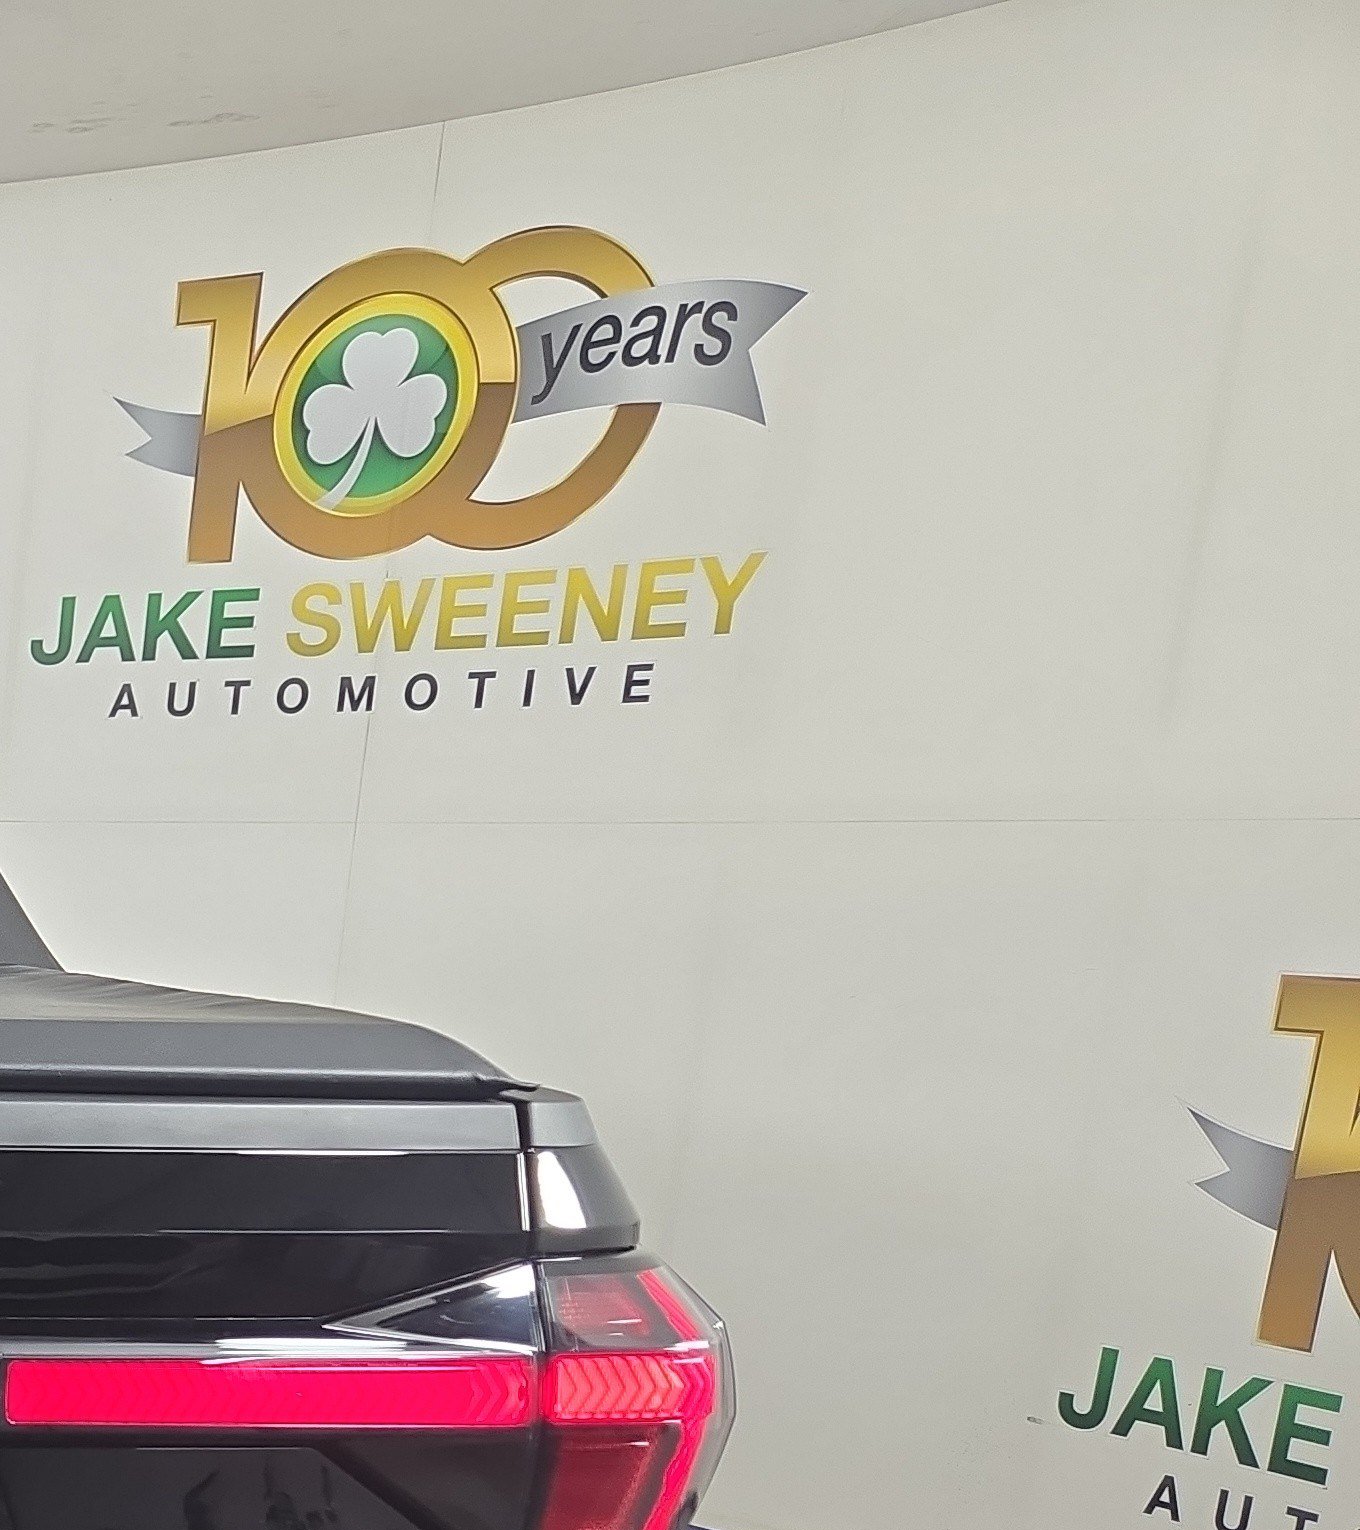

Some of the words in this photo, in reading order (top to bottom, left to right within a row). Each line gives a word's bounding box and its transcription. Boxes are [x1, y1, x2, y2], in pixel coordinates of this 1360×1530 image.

[176, 224, 663, 564] 100
[530, 297, 739, 406] years
[29, 587, 261, 666] JAKE
[286, 551, 769, 658] SWEENEY
[109, 662, 656, 719] AUTOMOTIVE
[1057, 1346, 1344, 1486] JAKE
